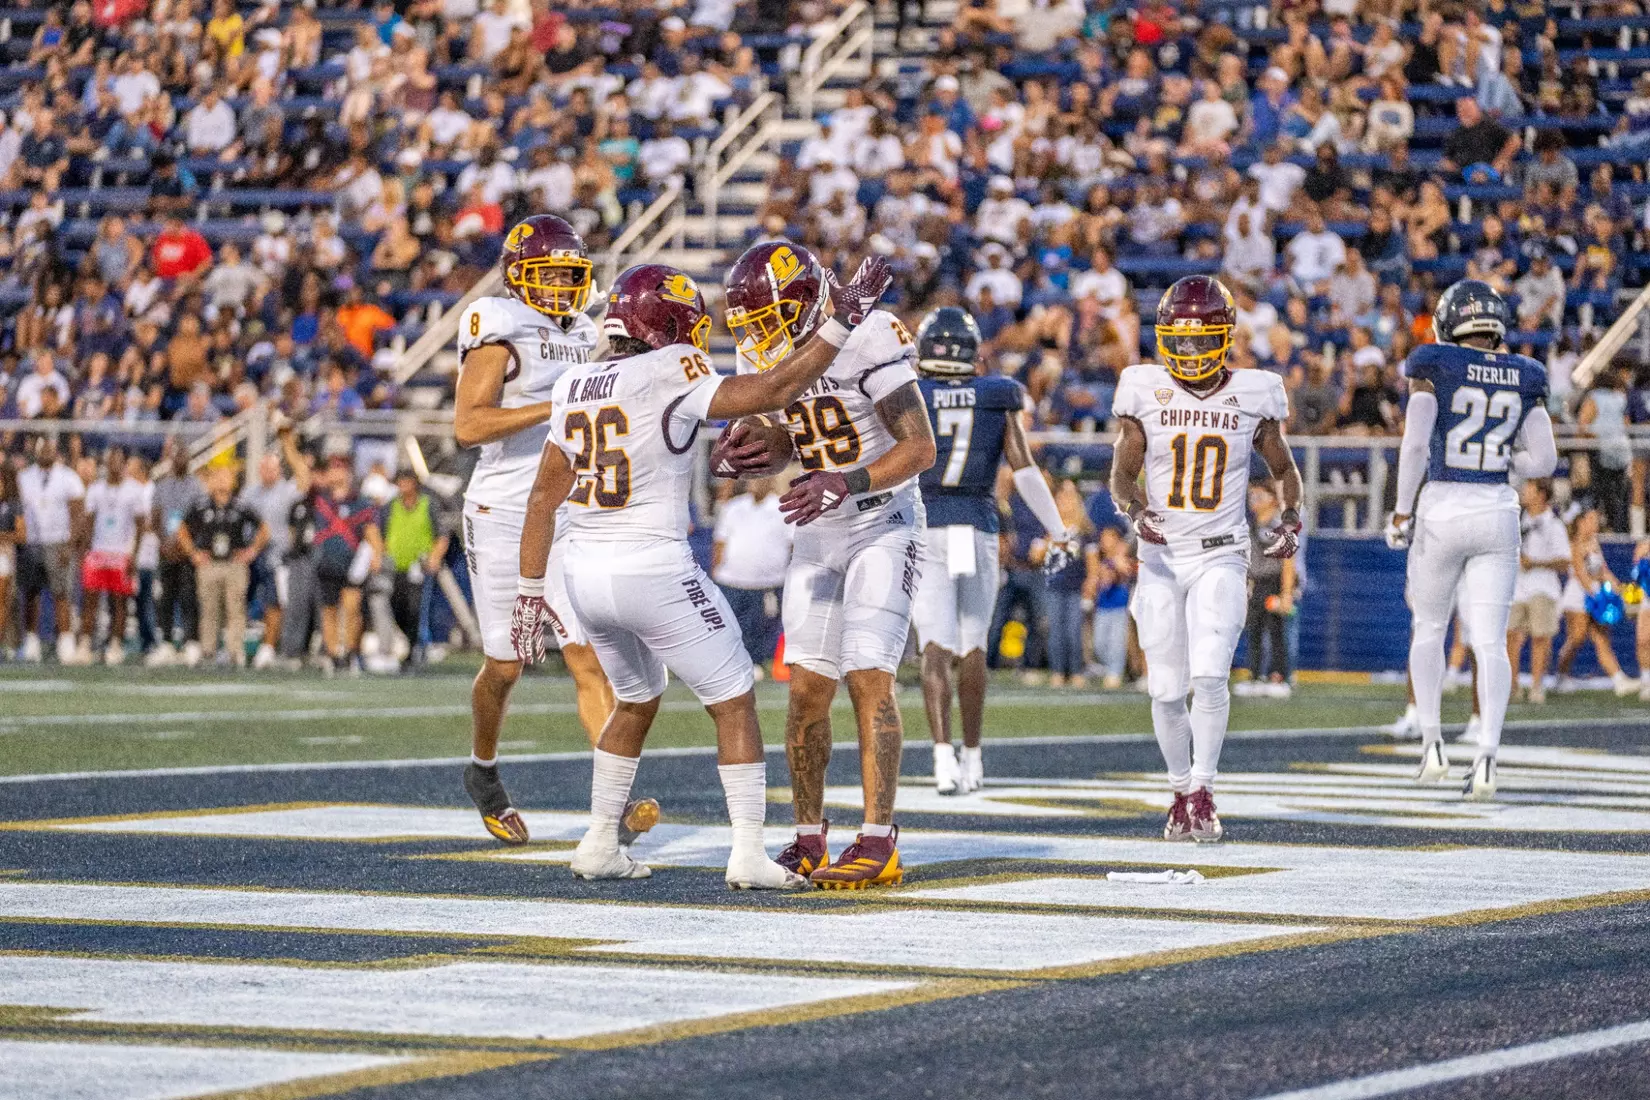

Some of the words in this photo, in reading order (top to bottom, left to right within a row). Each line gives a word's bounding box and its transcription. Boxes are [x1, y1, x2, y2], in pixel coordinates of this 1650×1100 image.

[469, 311, 480, 337] 8
[567, 378, 581, 404] M.
[580, 372, 619, 402] BAILEY
[680, 353, 711, 382] 26
[1466, 363, 1520, 386] STERLIN
[784, 395, 863, 472] 29
[1160, 408, 1240, 431] CHIPPEWAS
[1445, 385, 1522, 472] 22
[563, 404, 632, 510] 26
[937, 407, 974, 488] 7
[1167, 432, 1229, 513] 10
[681, 579, 712, 609] FIRE
[700, 607, 727, 632] UP!
